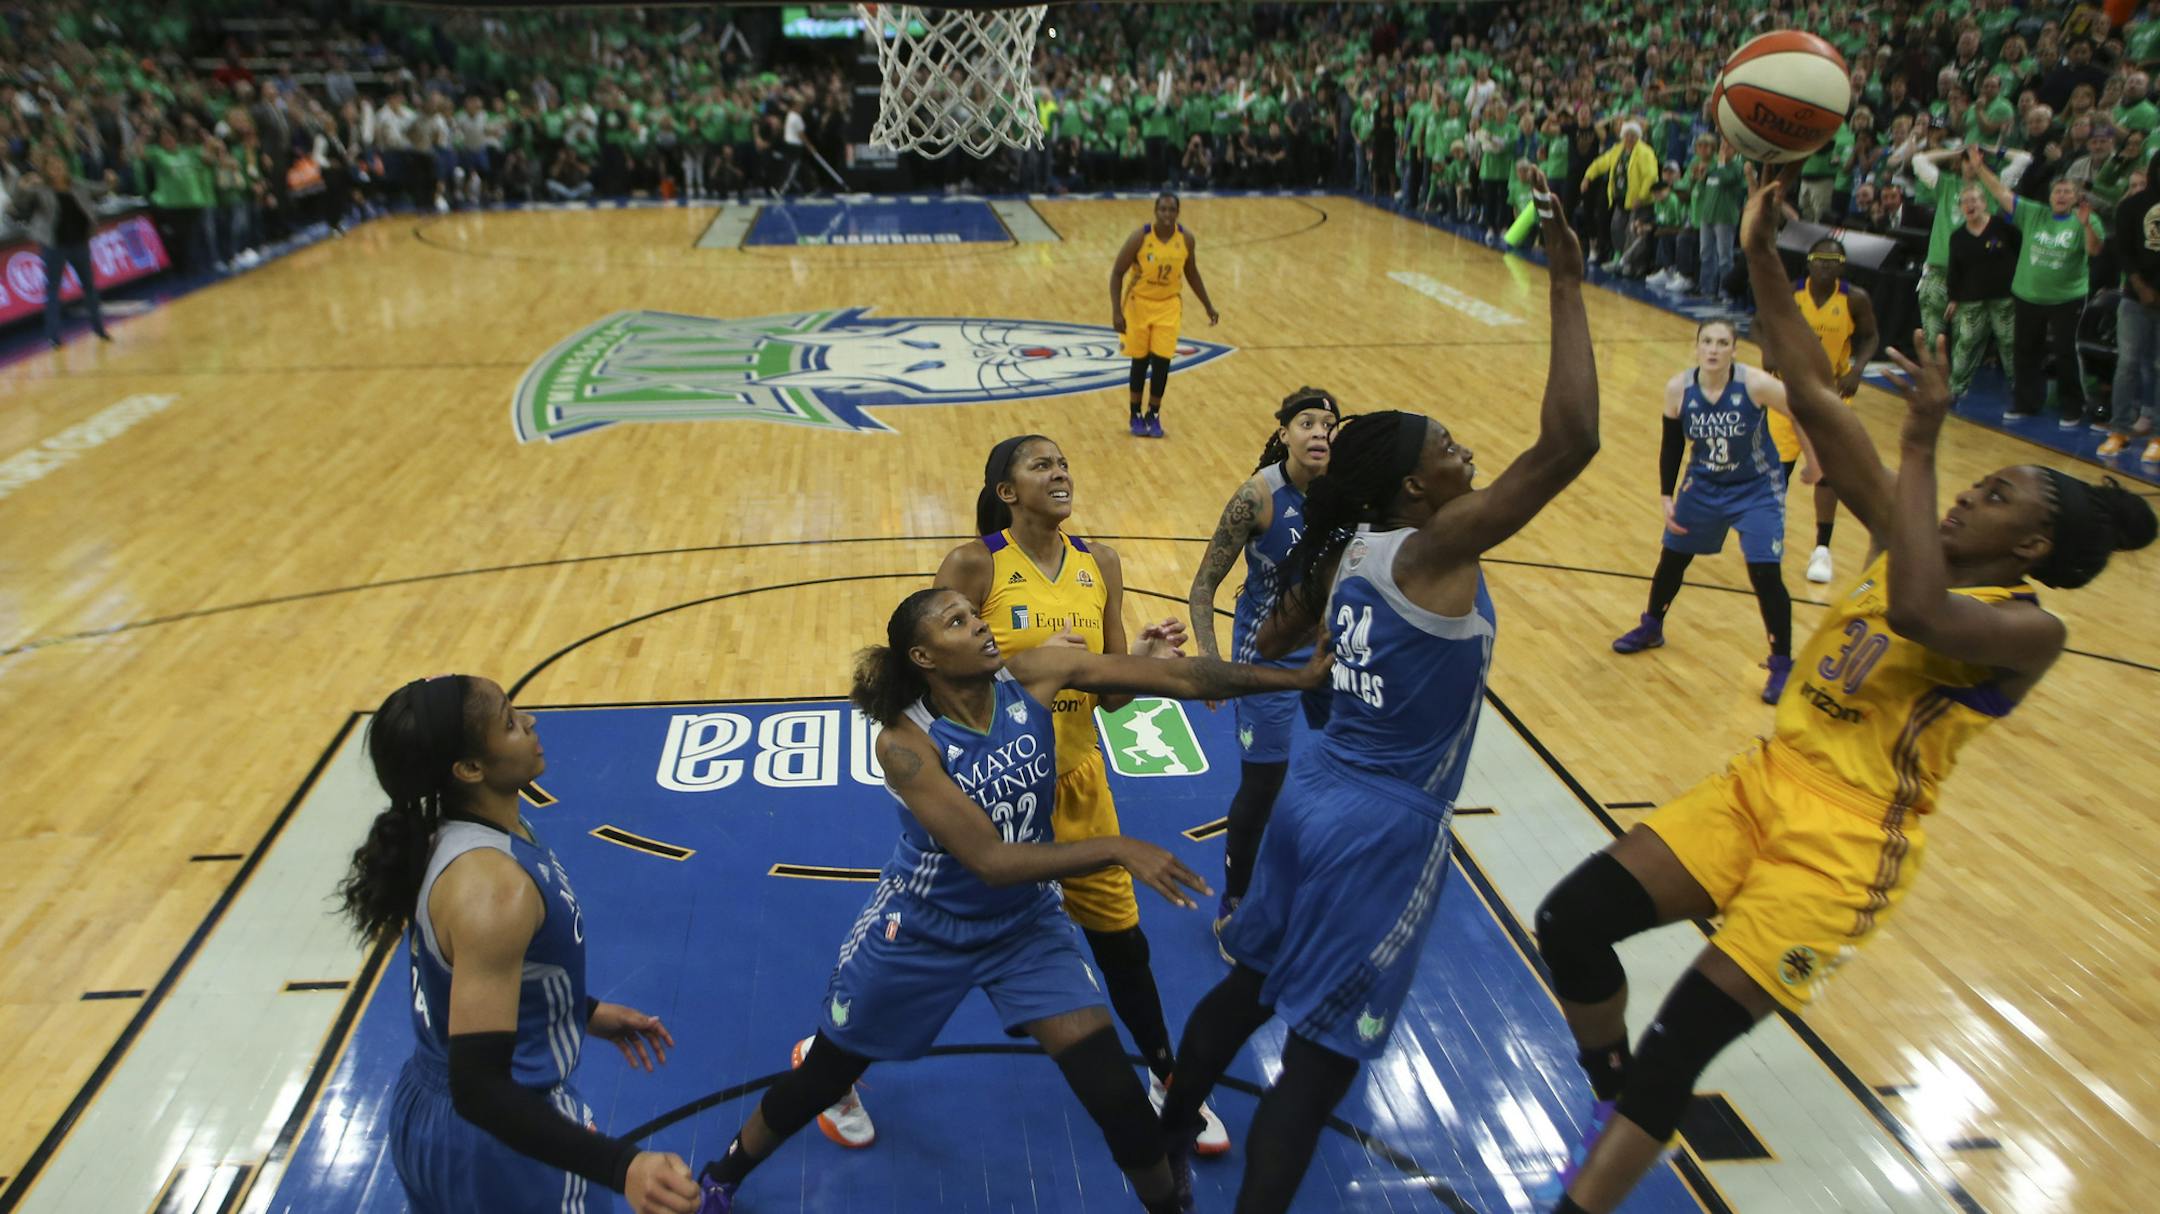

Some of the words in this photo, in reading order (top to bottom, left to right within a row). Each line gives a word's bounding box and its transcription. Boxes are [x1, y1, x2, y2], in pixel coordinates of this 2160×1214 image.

[1157, 264, 1172, 280] 12
[1689, 422, 1746, 438] CLINIC
[1690, 411, 1741, 425] MAYO
[1706, 437, 1728, 464] 13
[1336, 604, 1373, 667] 34
[1818, 617, 1889, 694] 30
[953, 734, 1037, 793] MAYO
[969, 753, 1050, 809] LINIC
[991, 791, 1038, 843] 32
